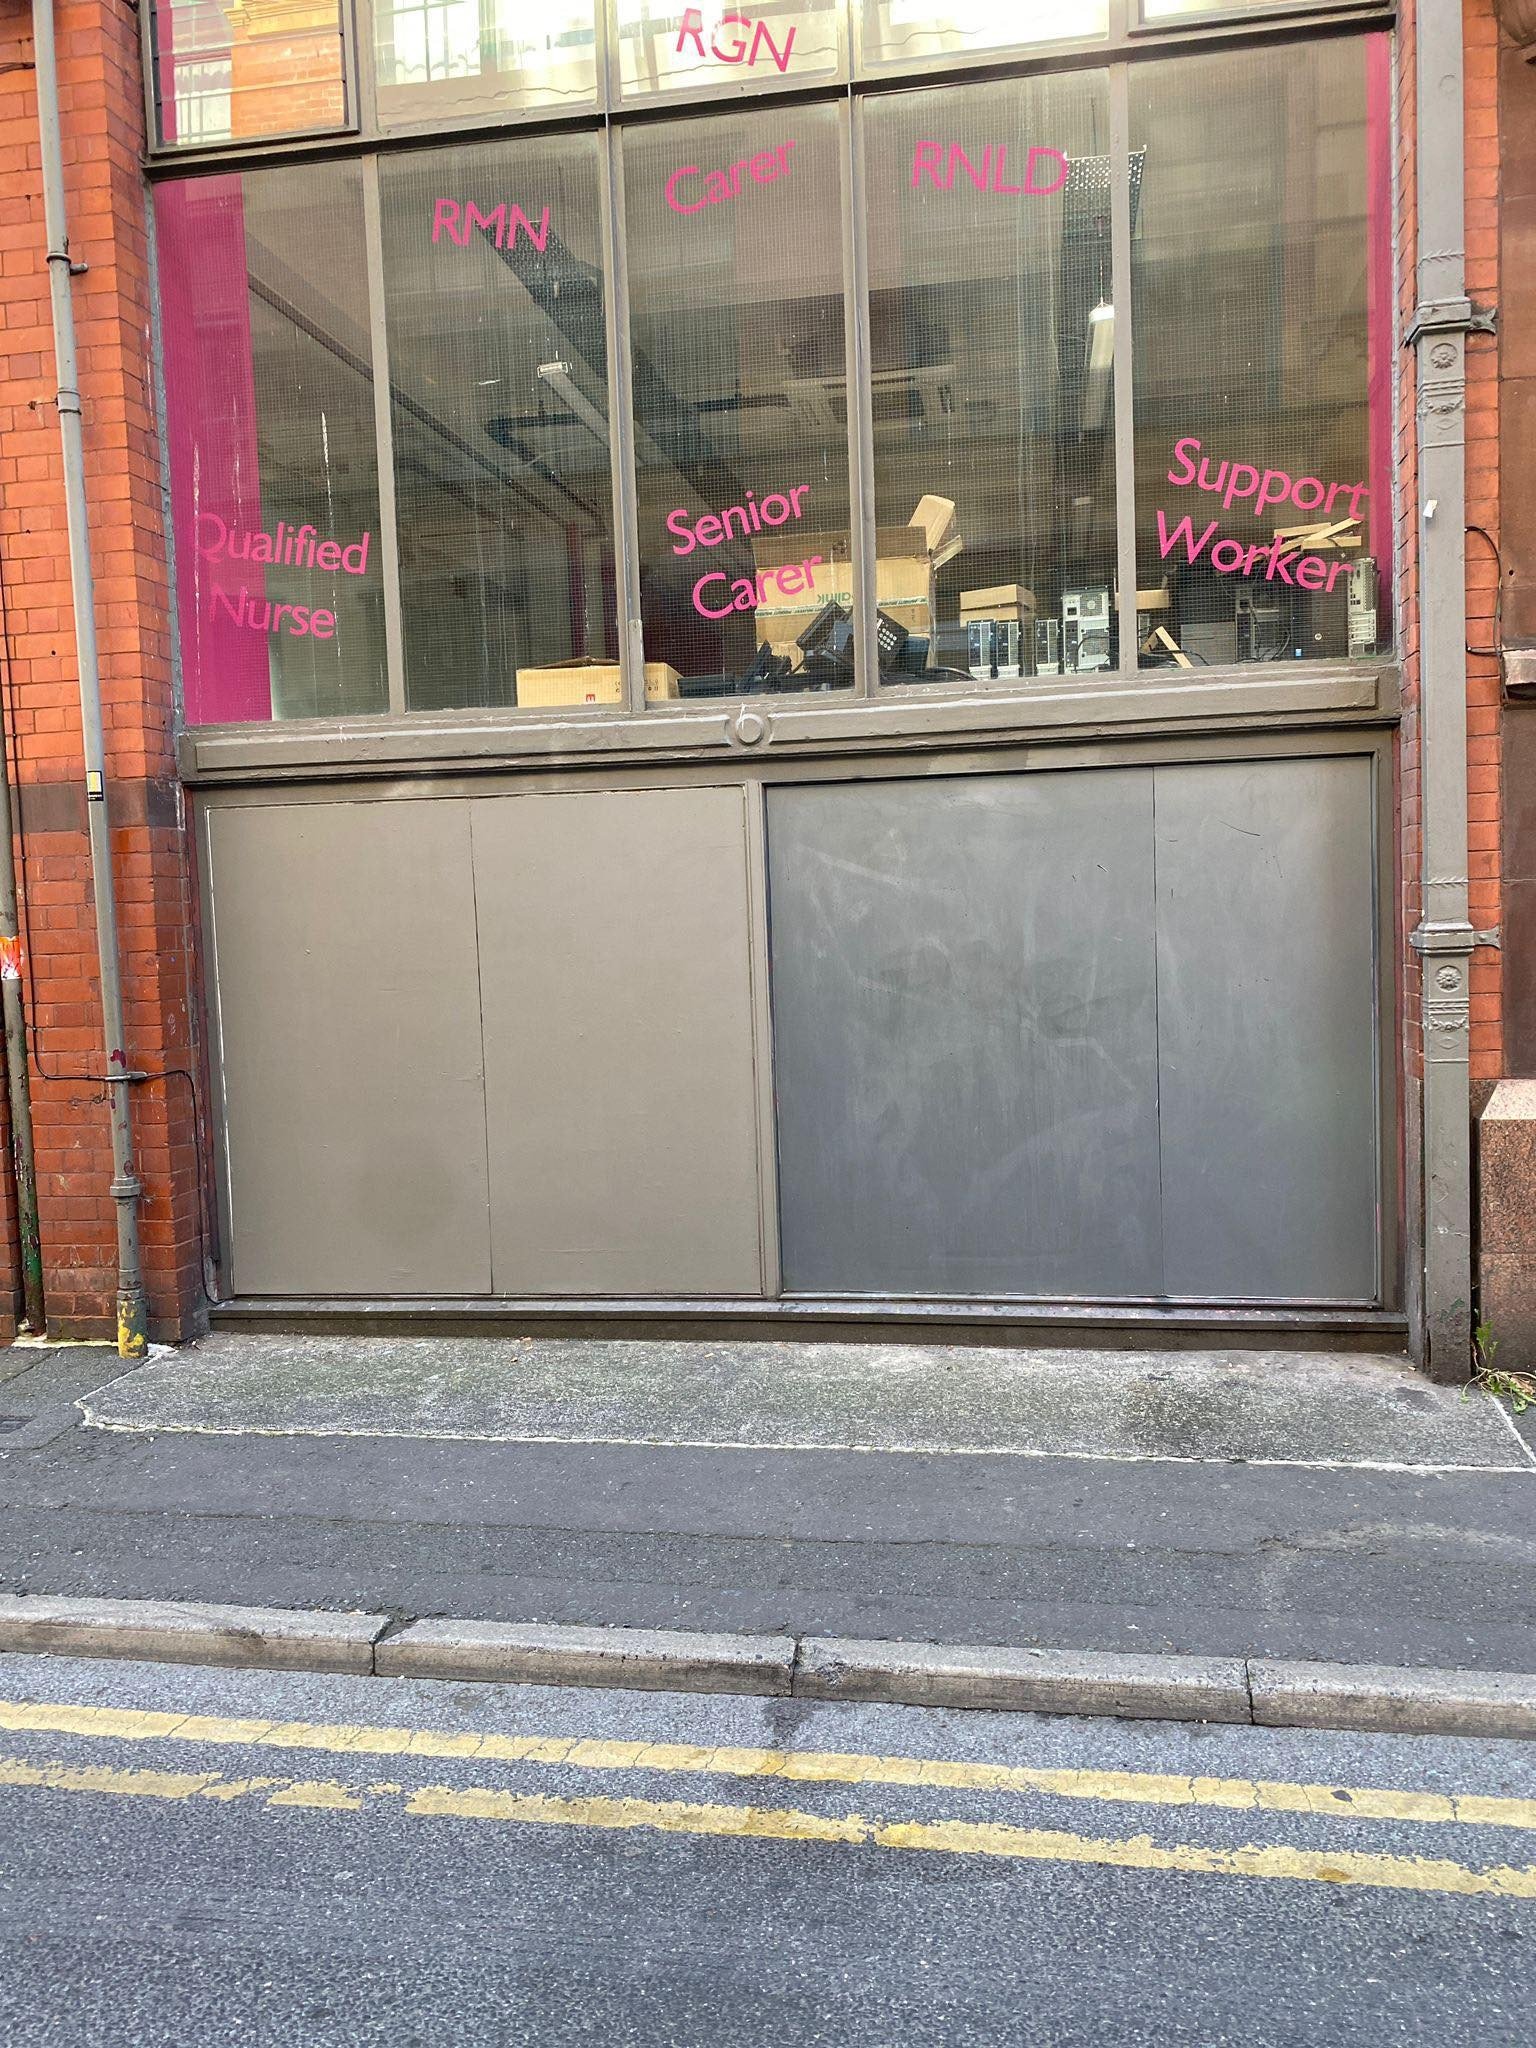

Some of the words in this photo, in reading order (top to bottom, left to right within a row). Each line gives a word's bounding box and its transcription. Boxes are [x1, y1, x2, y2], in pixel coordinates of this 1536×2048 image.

[676, 8, 796, 72] RGN
[664, 138, 796, 216] Carer
[911, 139, 1069, 195] RNLD
[432, 198, 550, 252] RMN
[1167, 437, 1371, 522] Support
[193, 512, 370, 575] Qualified
[666, 484, 810, 556] Senior
[1156, 508, 1355, 593] Worker
[209, 582, 336, 639] Nurse
[692, 555, 823, 619] Carer
